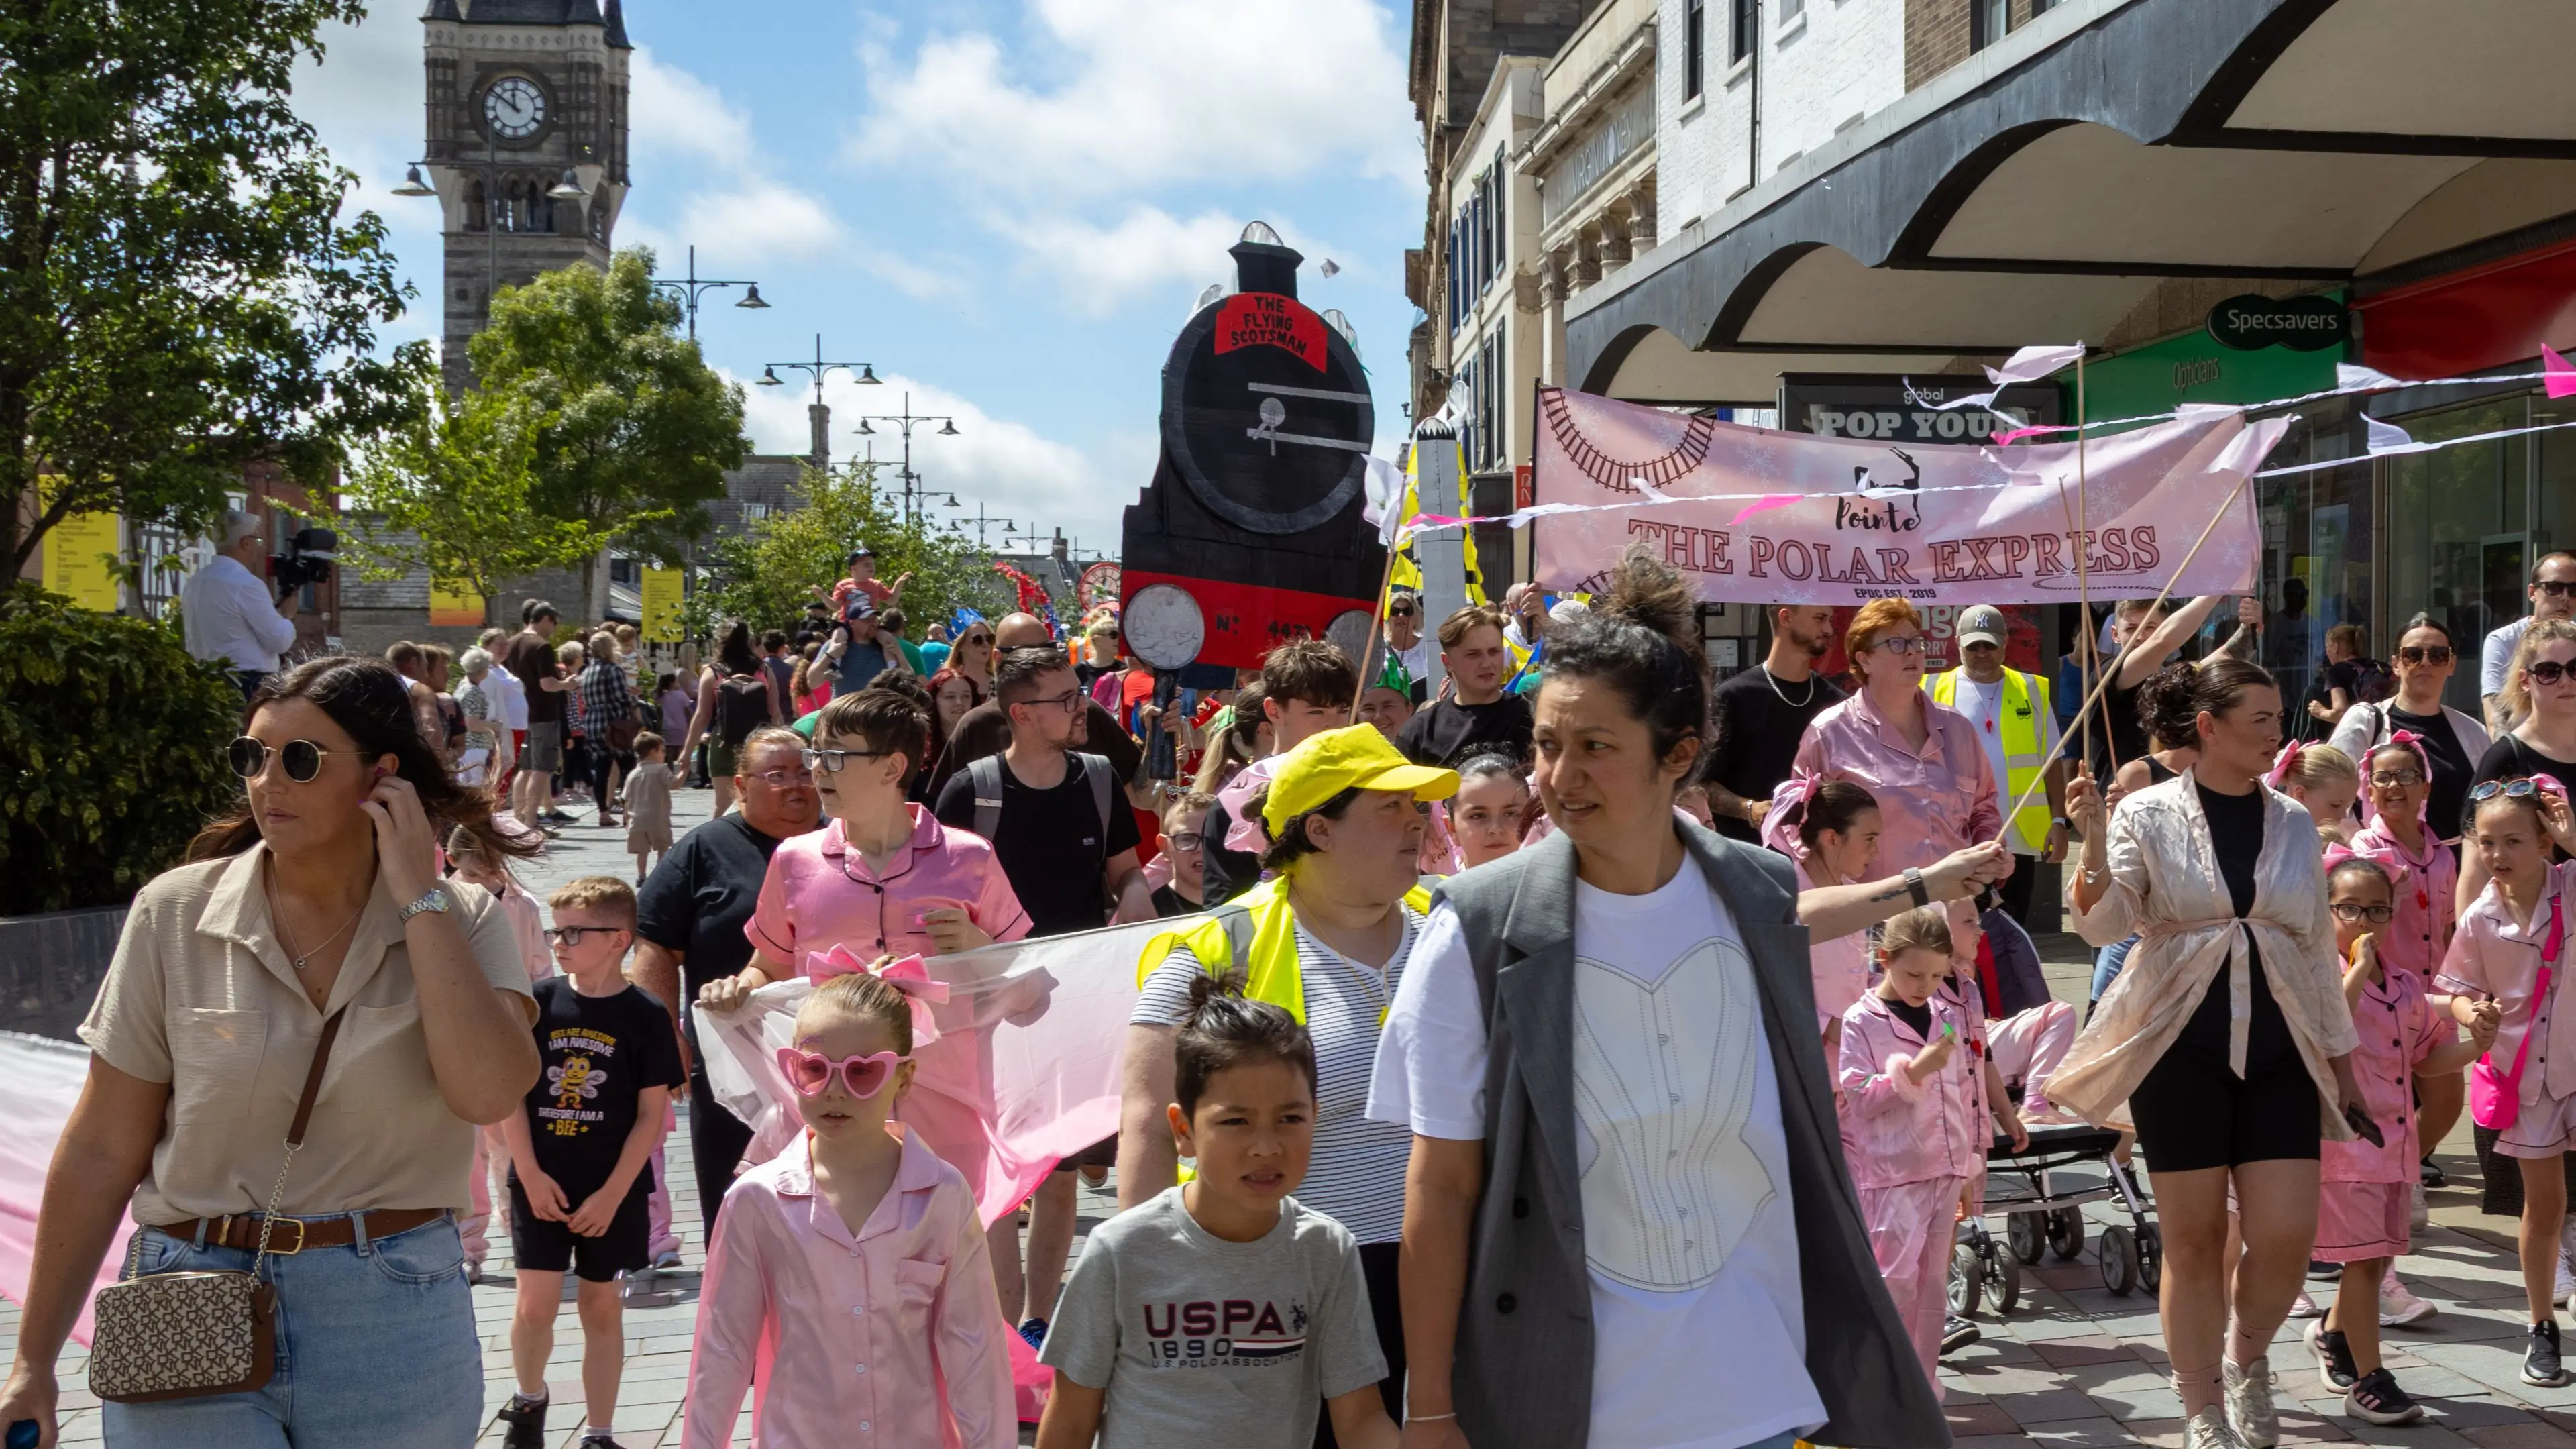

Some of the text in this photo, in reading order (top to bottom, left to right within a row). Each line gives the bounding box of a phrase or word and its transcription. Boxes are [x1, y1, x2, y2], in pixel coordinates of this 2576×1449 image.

[1254, 296, 1285, 313] THE
[1243, 313, 1293, 331] FLYING
[2228, 309, 2338, 333] Specsavers
[1231, 329, 1307, 356] SCOTSMAN
[2174, 356, 2219, 395] Opticians
[1903, 387, 1944, 405] global
[1819, 411, 1902, 437] POP
[1836, 496, 1917, 533] Pointe
[1628, 519, 2160, 584] THE POLAR EXPRESS
[1854, 588, 1882, 598] EPDC
[1909, 588, 1937, 598] 2019
[548, 1036, 616, 1057] I AM AWESOME
[575, 1110, 580, 1120] I
[580, 1110, 596, 1121] AM
[596, 1111, 604, 1121] A
[555, 1119, 579, 1136] BEE
[1143, 1300, 1286, 1338] USPA
[1148, 1338, 1232, 1359] 1890
[1179, 1358, 1217, 1368] POLO
